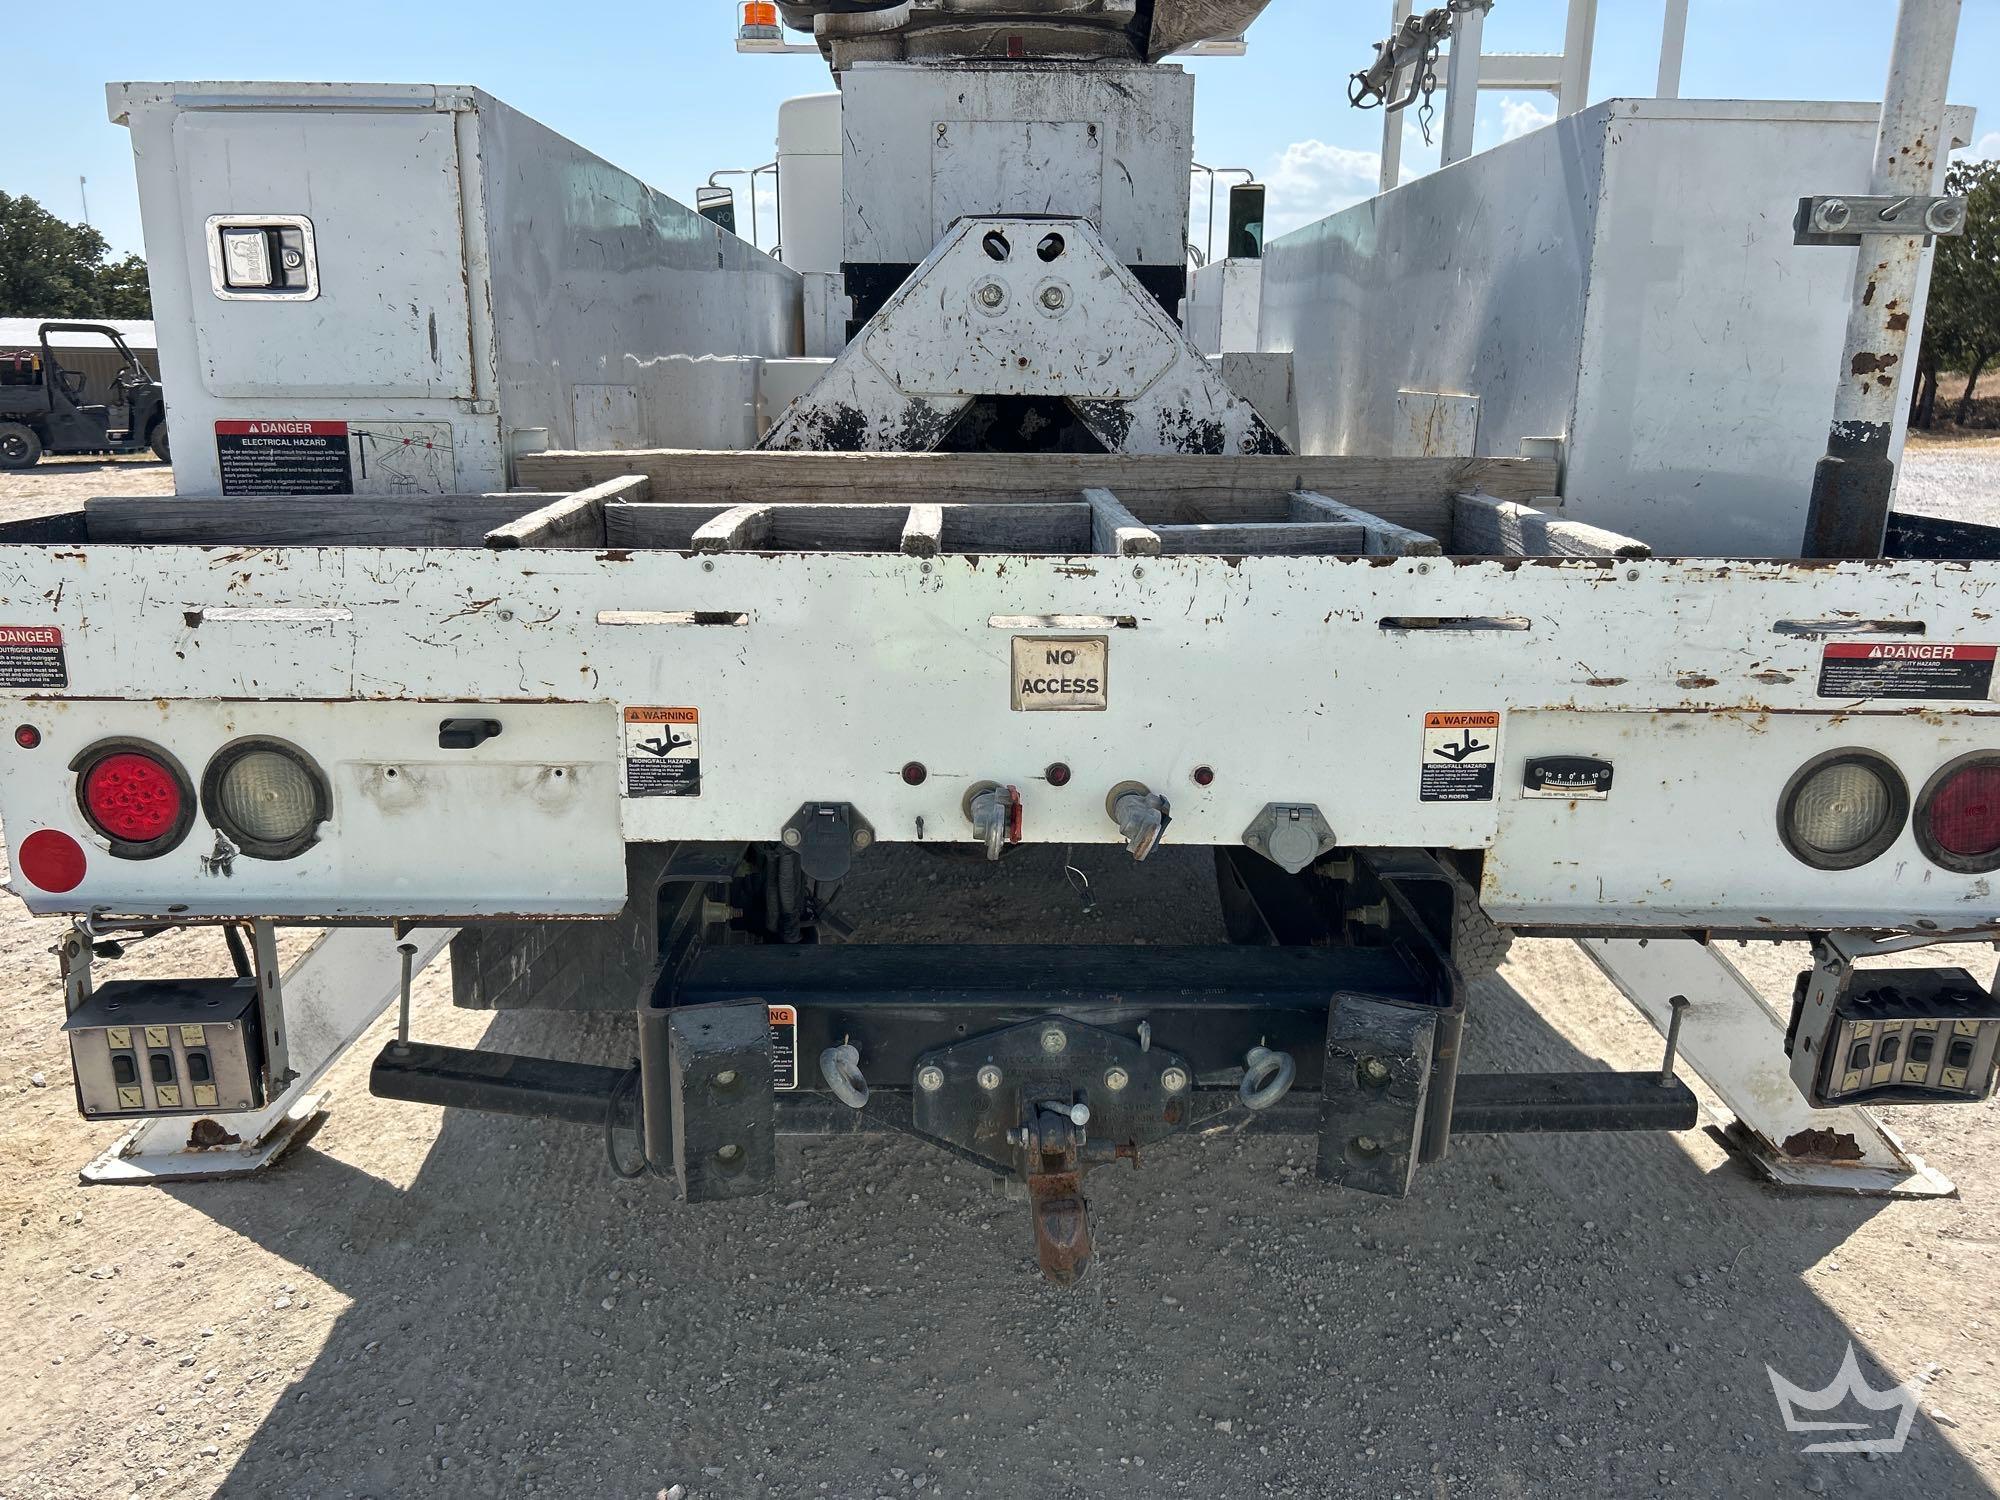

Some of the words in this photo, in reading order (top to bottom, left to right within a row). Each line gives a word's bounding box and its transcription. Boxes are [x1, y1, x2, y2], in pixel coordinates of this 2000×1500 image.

[261, 423, 312, 433] DANGER
[242, 438, 292, 446] ELECTRICAL
[0, 631, 54, 642] DANGER
[1046, 650, 1076, 664] NO
[1883, 646, 1954, 659] DANGER
[1021, 679, 1099, 694] ACCESS
[643, 712, 694, 720] WARNING
[1444, 716, 1494, 724] WARNING
